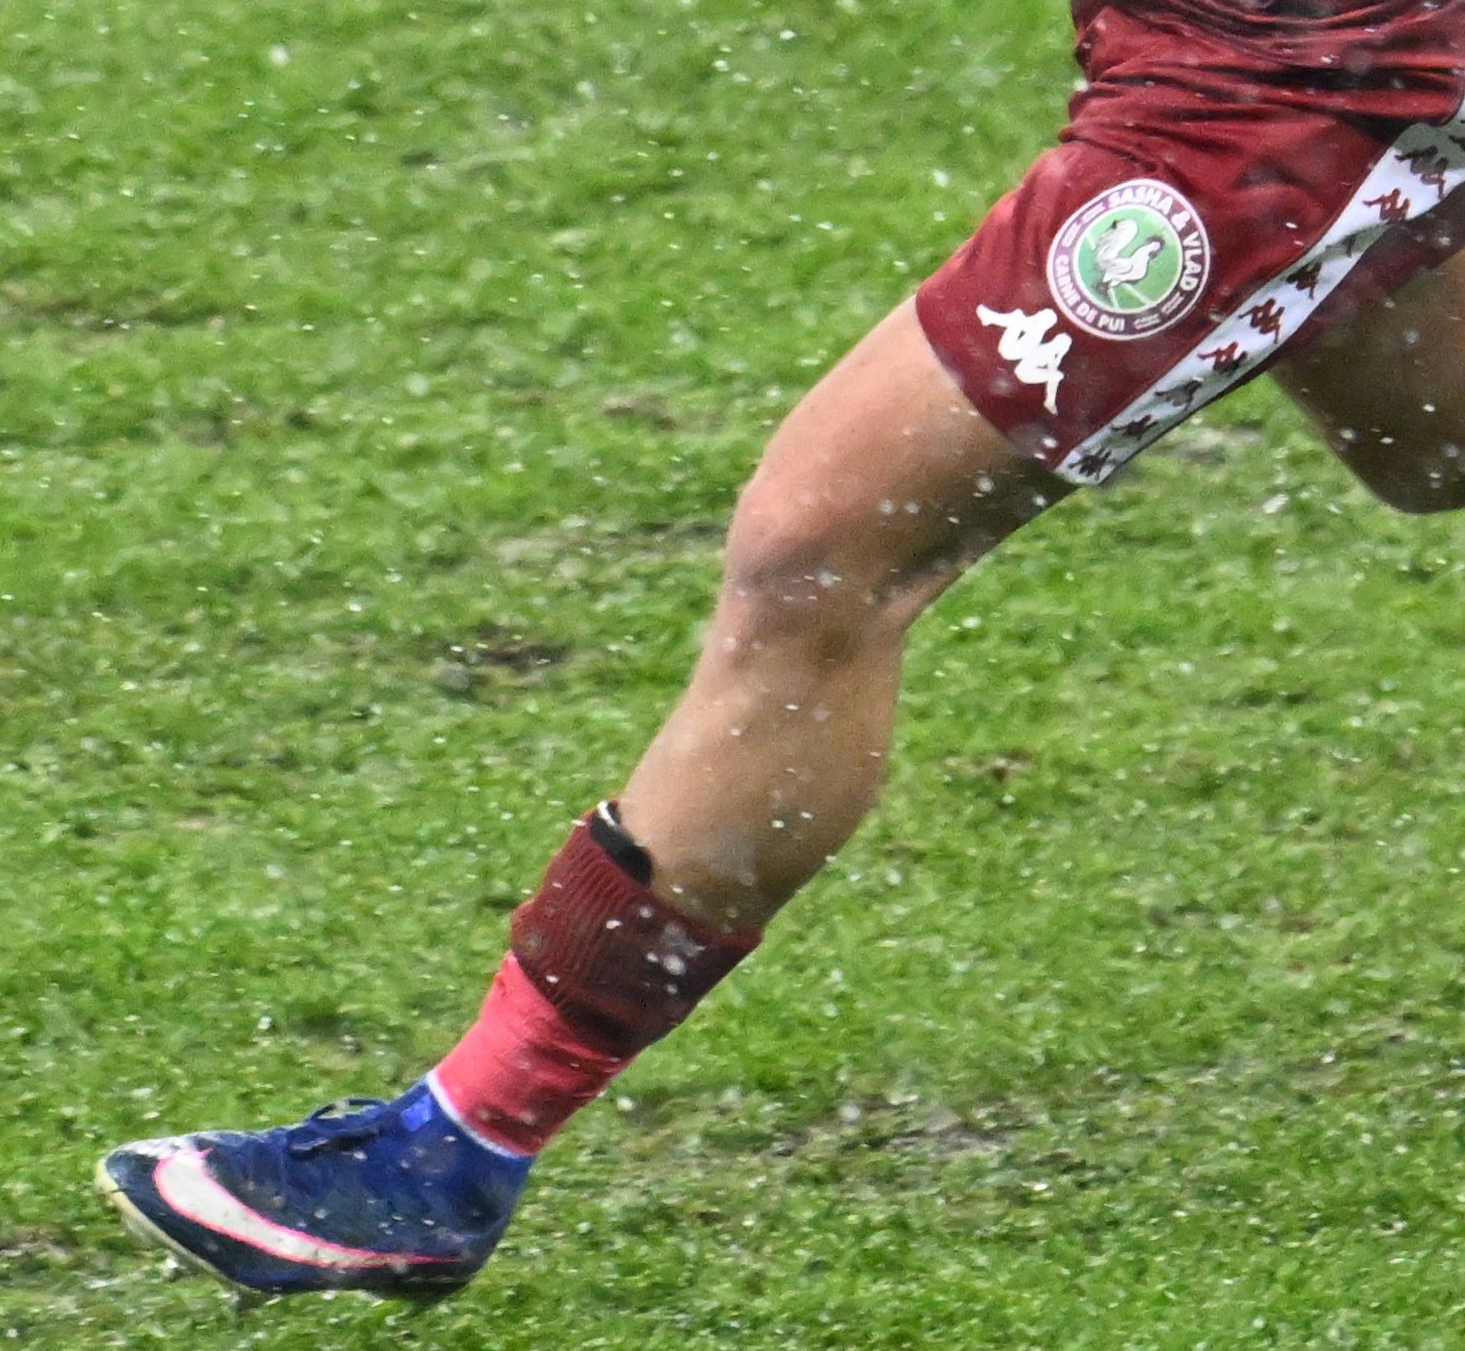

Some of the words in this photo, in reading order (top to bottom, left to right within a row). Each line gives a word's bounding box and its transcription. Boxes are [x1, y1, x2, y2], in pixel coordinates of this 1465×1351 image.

[1107, 186, 1174, 215] SASHA
[1171, 211, 1191, 231] &
[1180, 230, 1202, 291] VLAD
[1055, 254, 1081, 307] CARNE
[1075, 300, 1099, 323] DE
[1098, 314, 1125, 331] PUI
